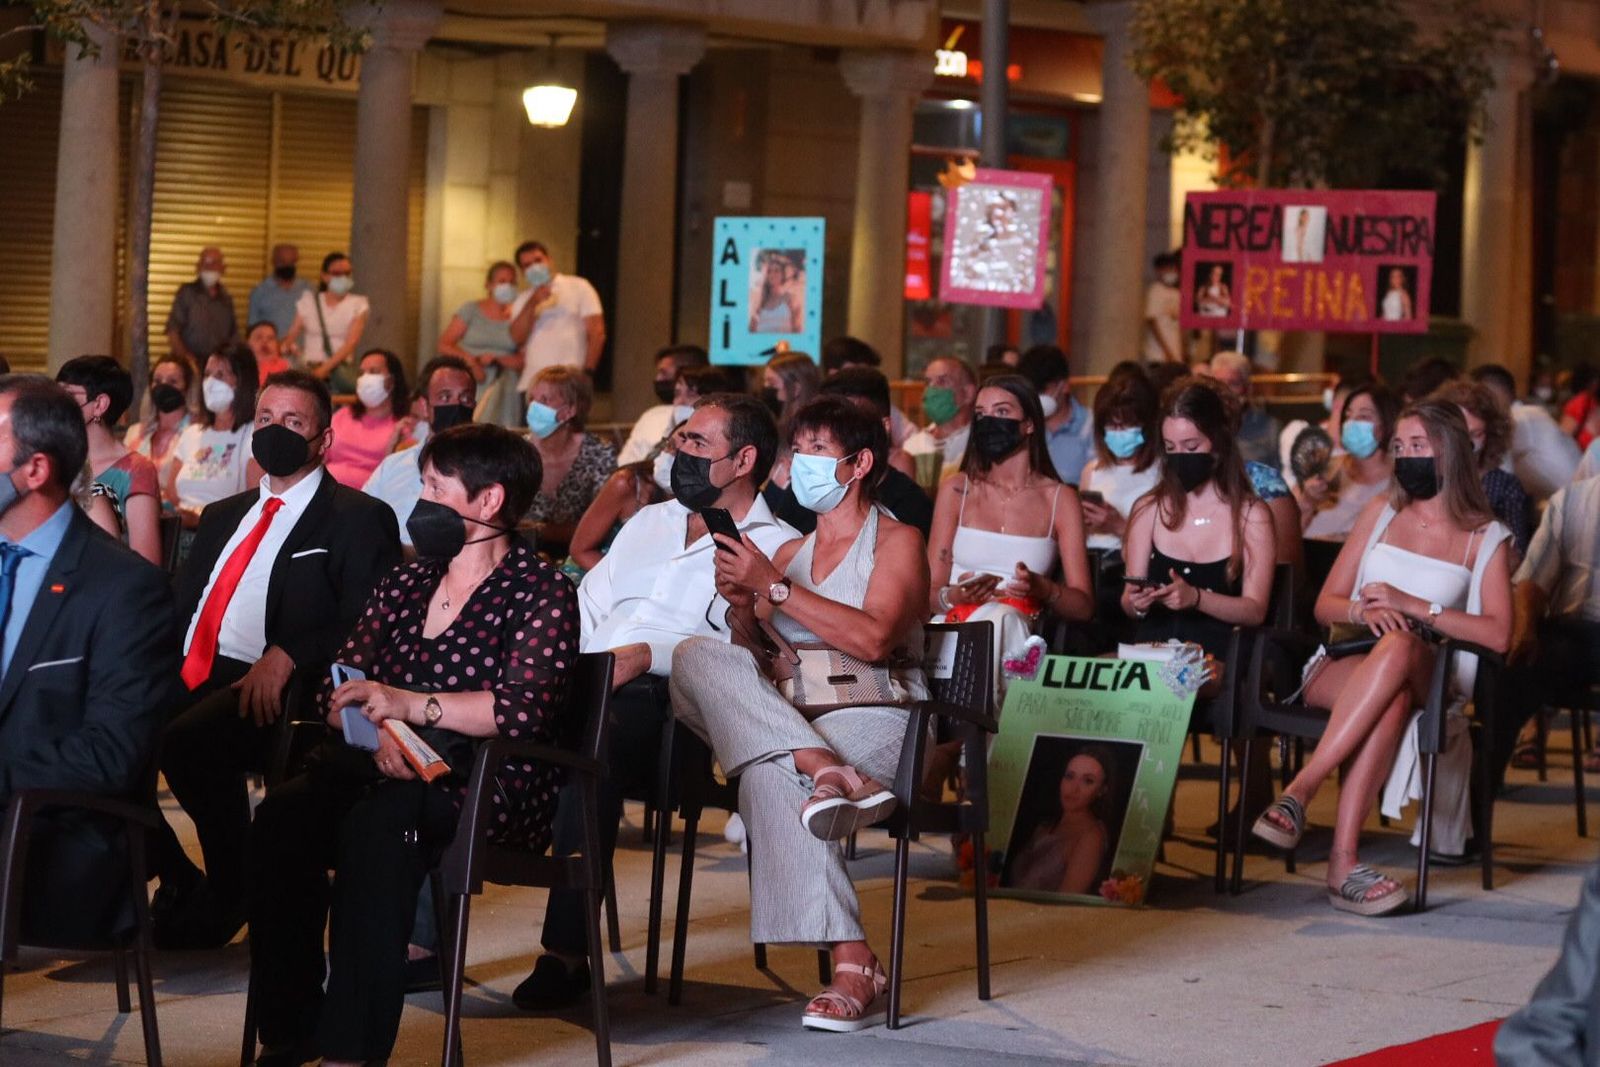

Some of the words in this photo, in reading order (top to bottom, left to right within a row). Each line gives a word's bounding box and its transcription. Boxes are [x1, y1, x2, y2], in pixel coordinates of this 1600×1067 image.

[245, 33, 301, 77] DEL
[317, 43, 360, 83] QU
[1182, 200, 1283, 251] NEREA
[1324, 213, 1434, 258] NUESTRA
[1245, 266, 1368, 321] REINA
